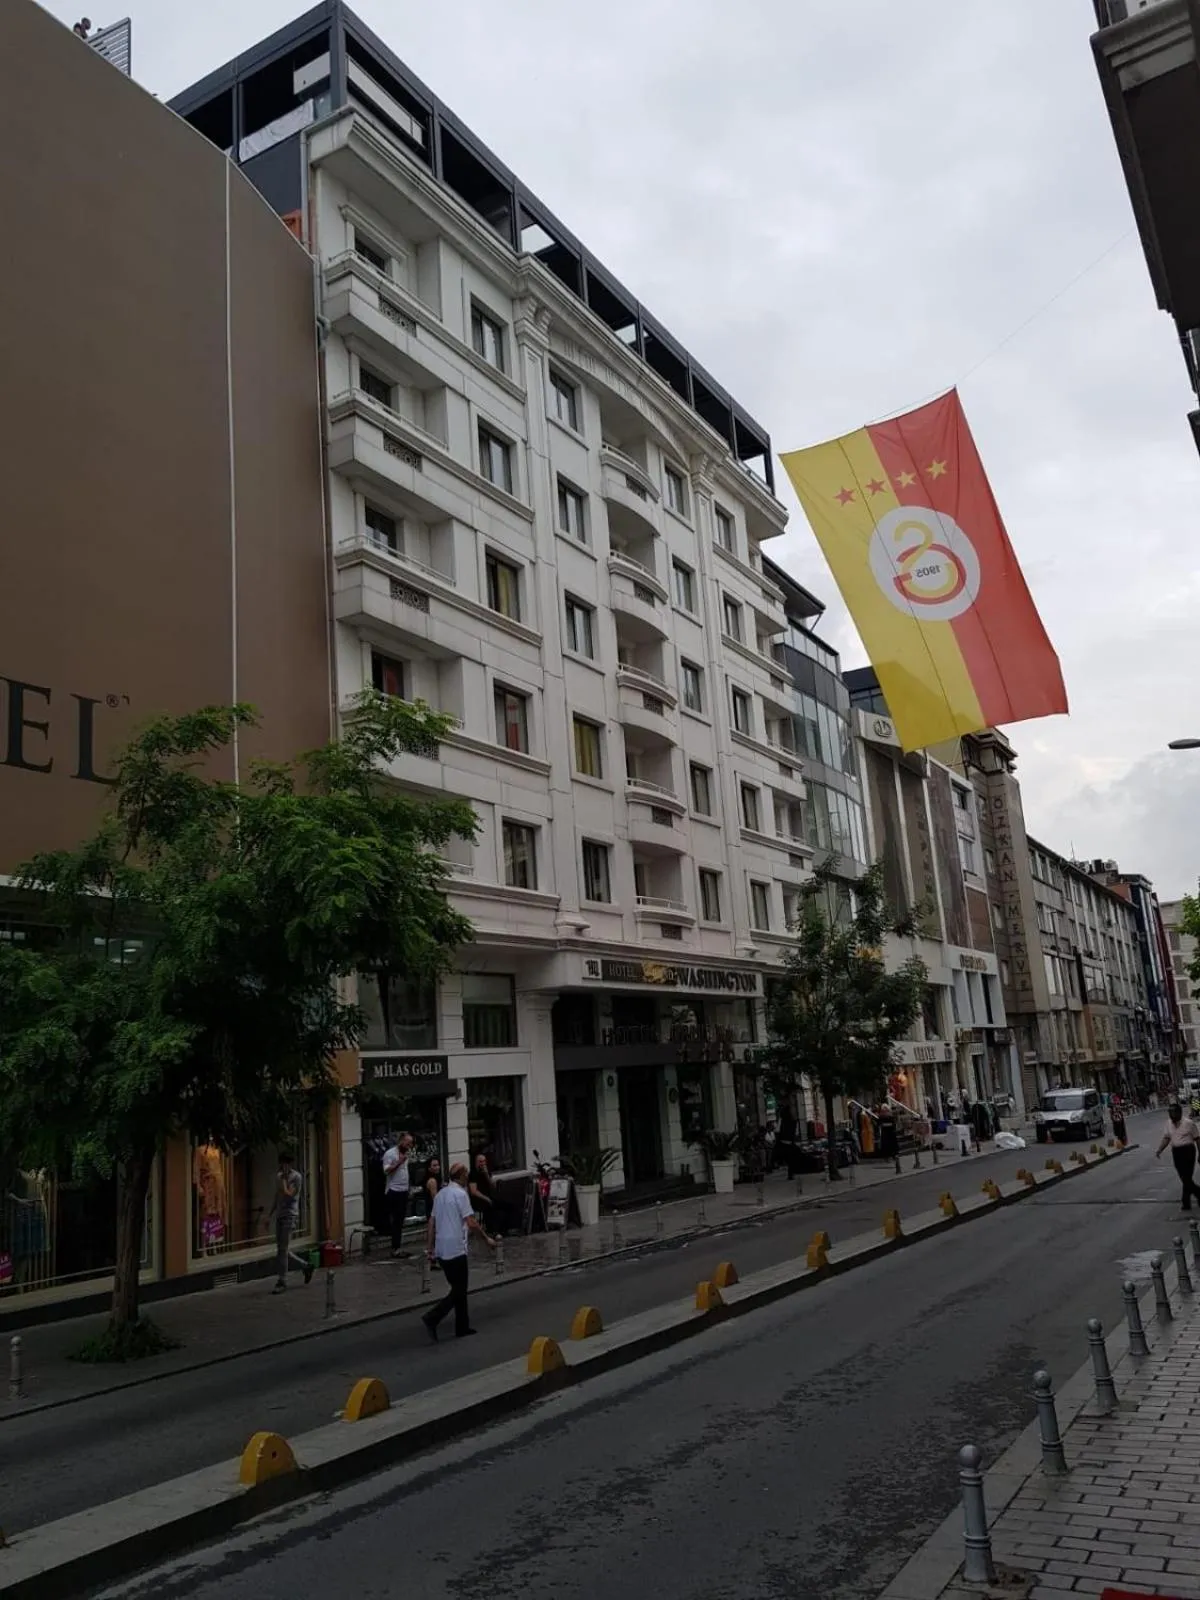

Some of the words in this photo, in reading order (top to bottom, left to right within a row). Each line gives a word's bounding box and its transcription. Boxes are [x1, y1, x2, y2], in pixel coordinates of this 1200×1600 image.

[677, 968, 757, 991] WASHINGTON
[373, 1061, 410, 1078] MİLAS
[412, 1062, 442, 1076] GOLD
